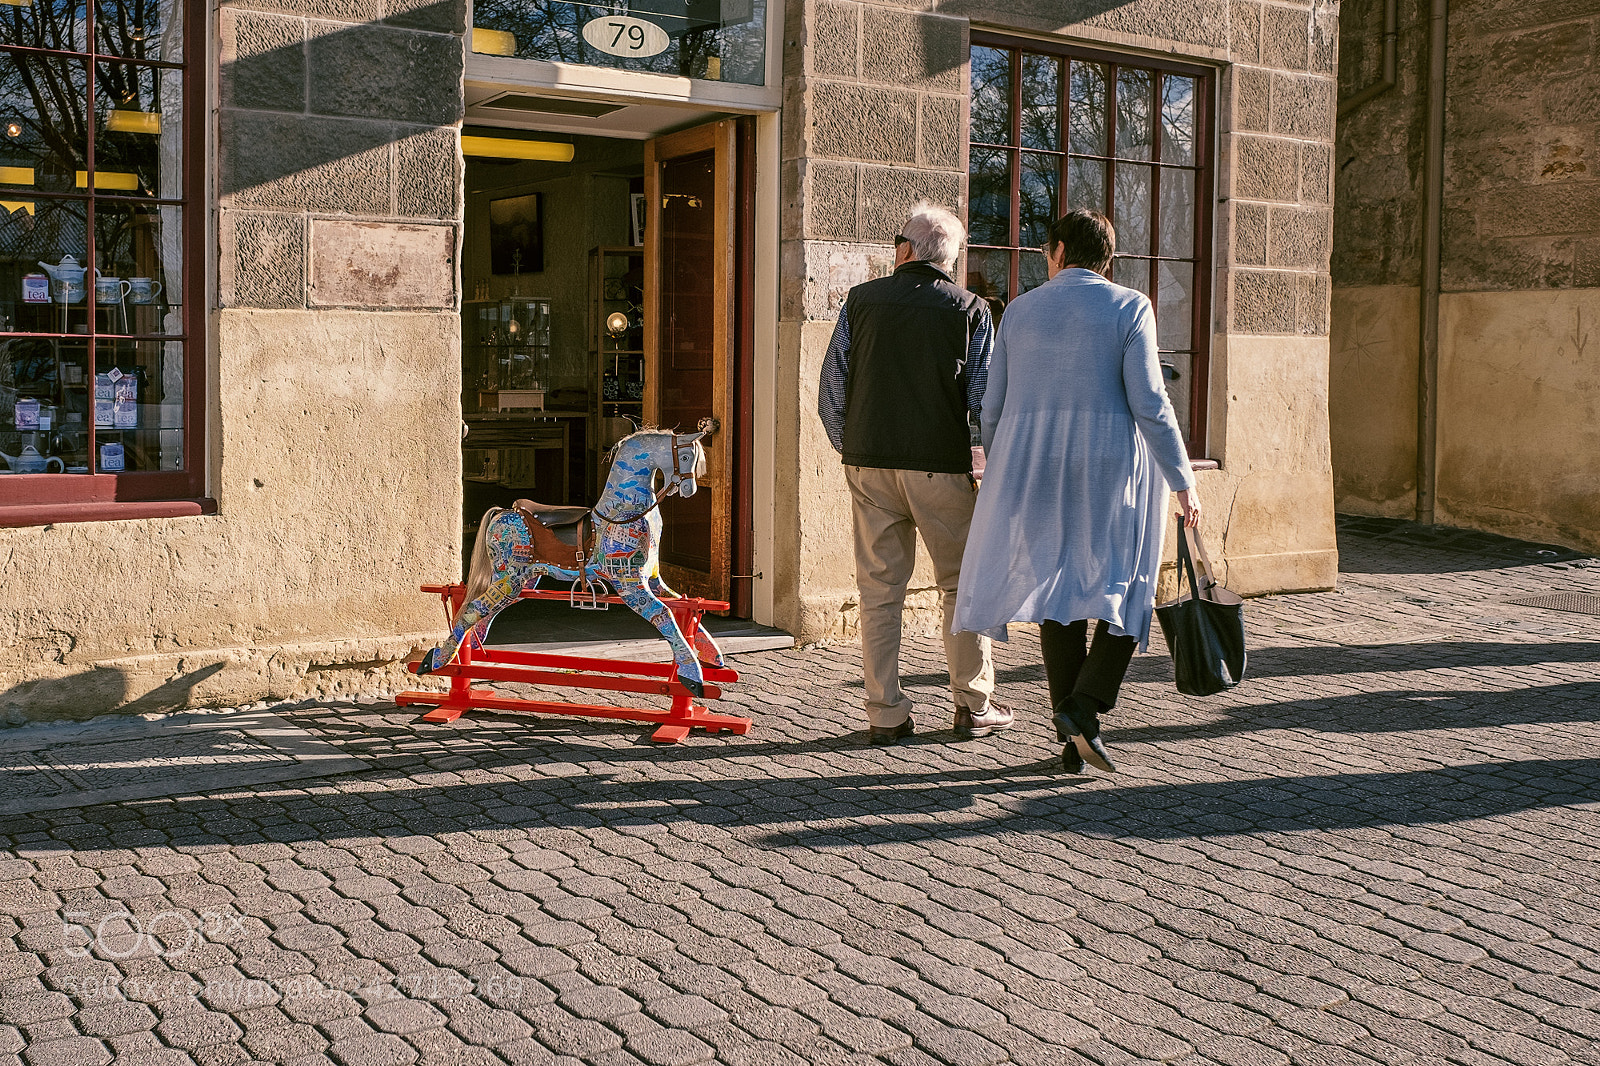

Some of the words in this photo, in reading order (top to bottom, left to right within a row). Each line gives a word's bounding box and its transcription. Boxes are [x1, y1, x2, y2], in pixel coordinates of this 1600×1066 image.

[608, 22, 645, 50] 79
[28, 290, 45, 299] tea
[116, 388, 133, 399] ea
[95, 413, 109, 422] ea
[117, 413, 133, 423] tea
[104, 458, 121, 467] tea
